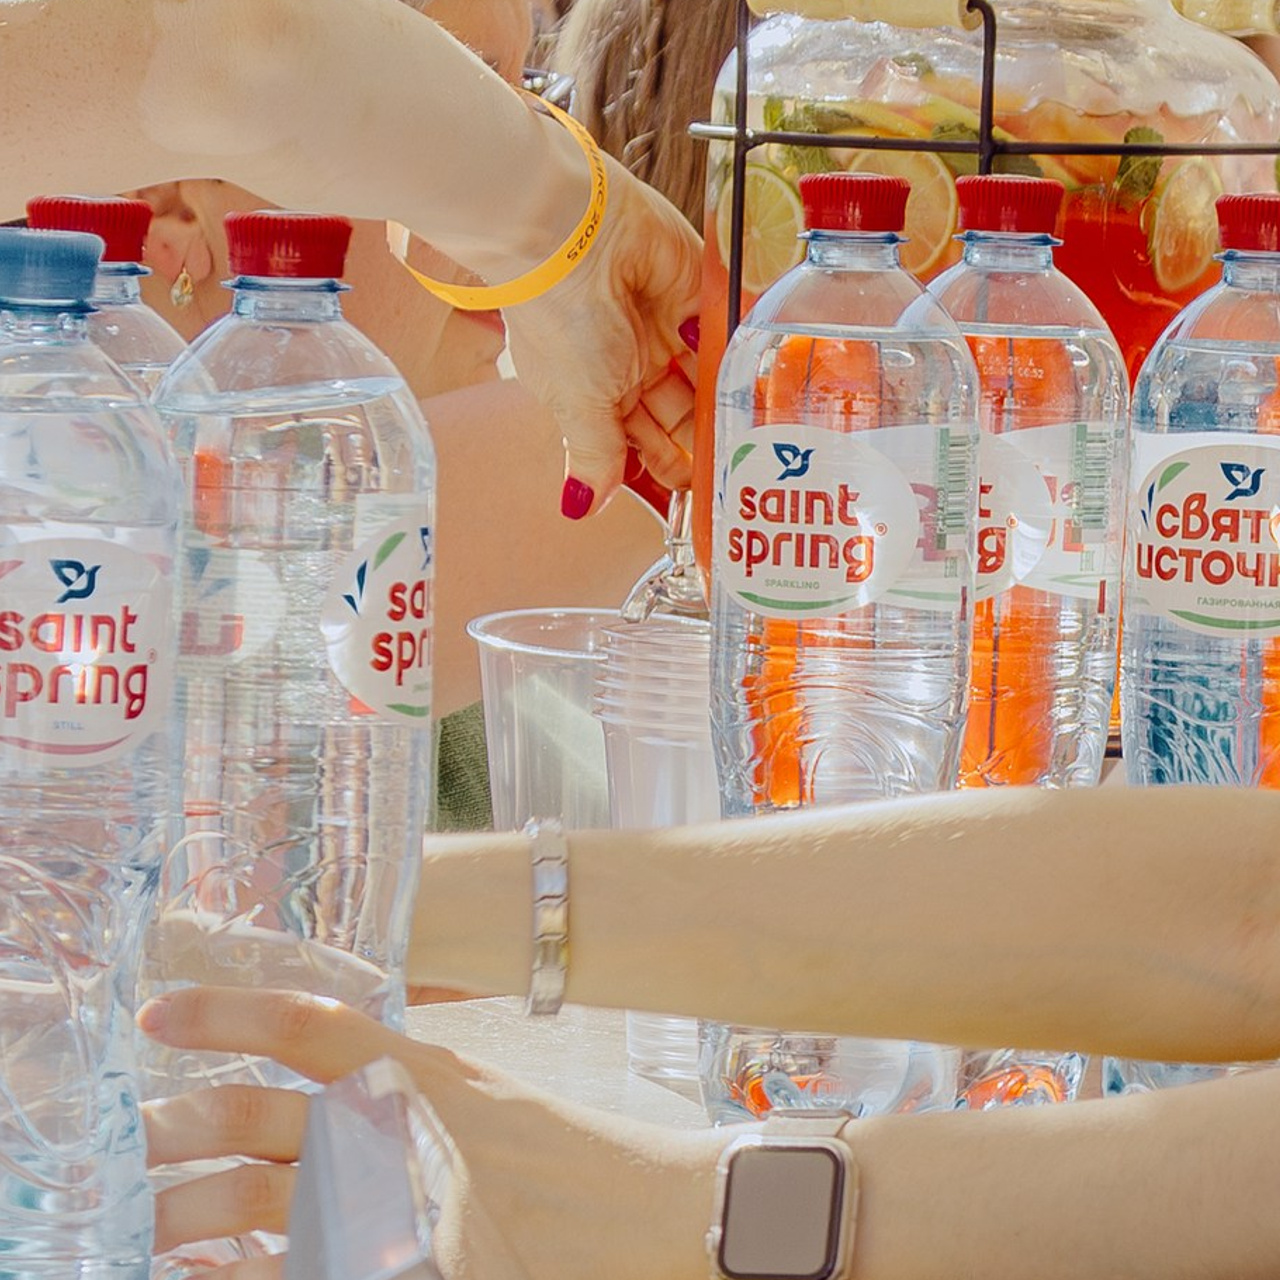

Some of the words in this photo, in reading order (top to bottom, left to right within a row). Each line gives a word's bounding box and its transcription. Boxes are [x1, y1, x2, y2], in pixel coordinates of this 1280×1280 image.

[566, 211, 602, 261] 2025
[738, 484, 860, 526] saint
[728, 527, 875, 583] spring
[764, 578, 820, 590] SPARKLING
[0, 605, 138, 653] saint
[370, 629, 431, 687] spr
[0, 663, 148, 720] pring
